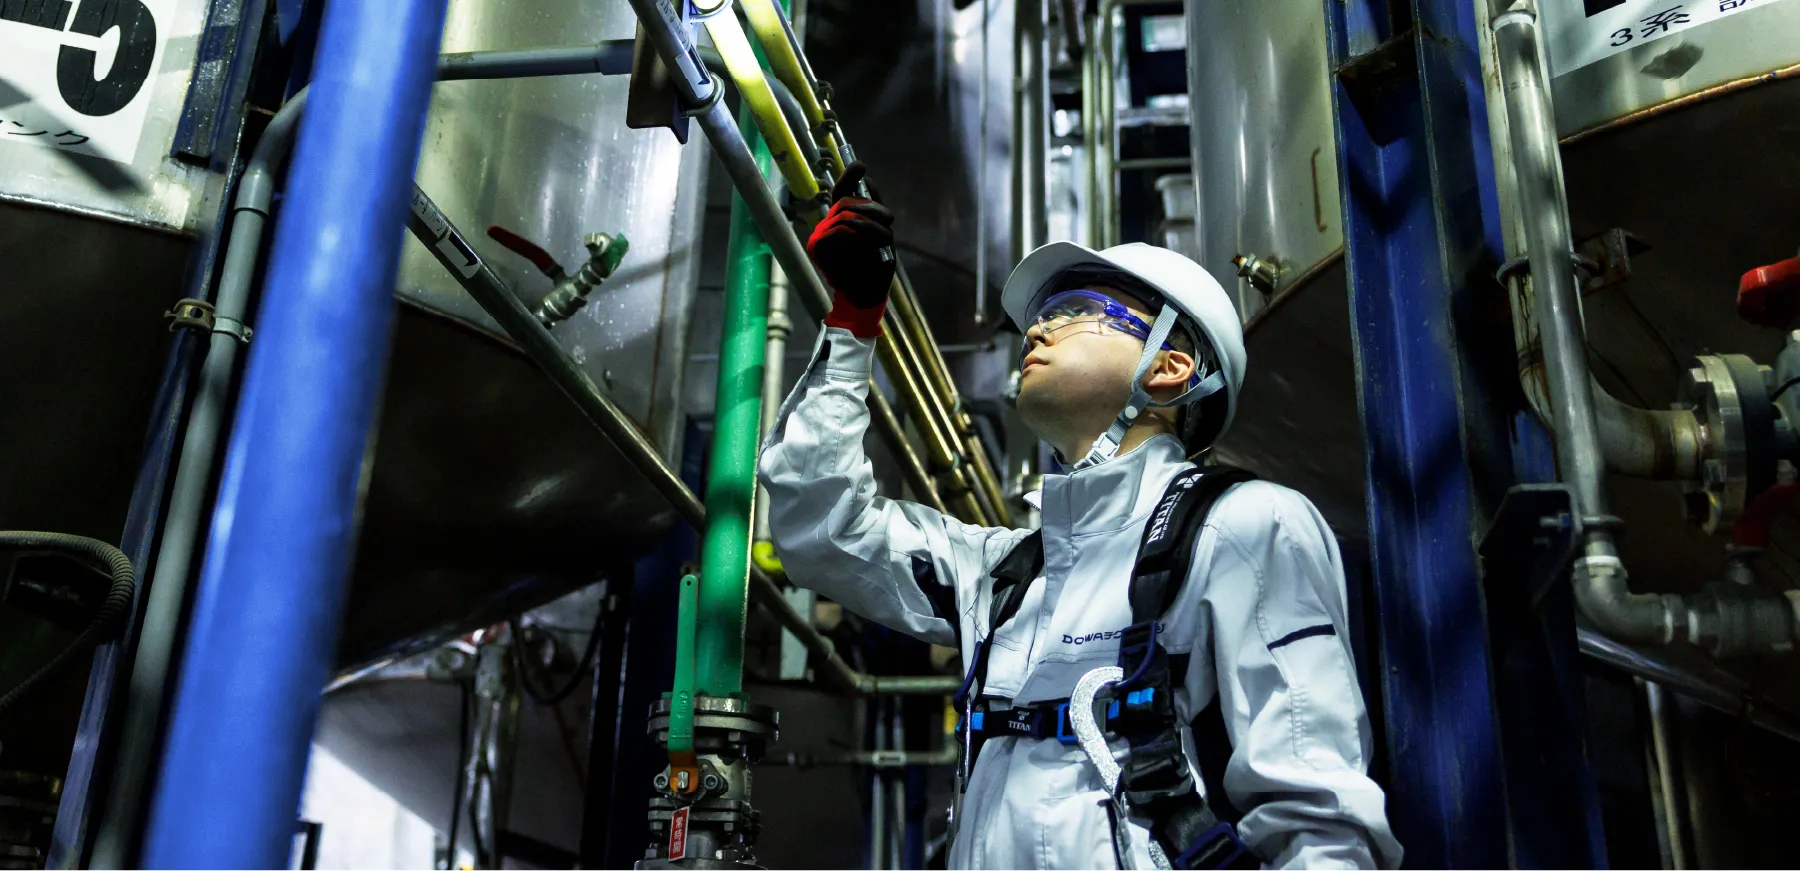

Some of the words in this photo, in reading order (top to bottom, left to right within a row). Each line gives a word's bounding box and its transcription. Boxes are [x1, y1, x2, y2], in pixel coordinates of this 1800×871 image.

[0, 119, 90, 146] ンク
[1146, 491, 1181, 544] TITAN
[1008, 721, 1031, 731] TITAN
